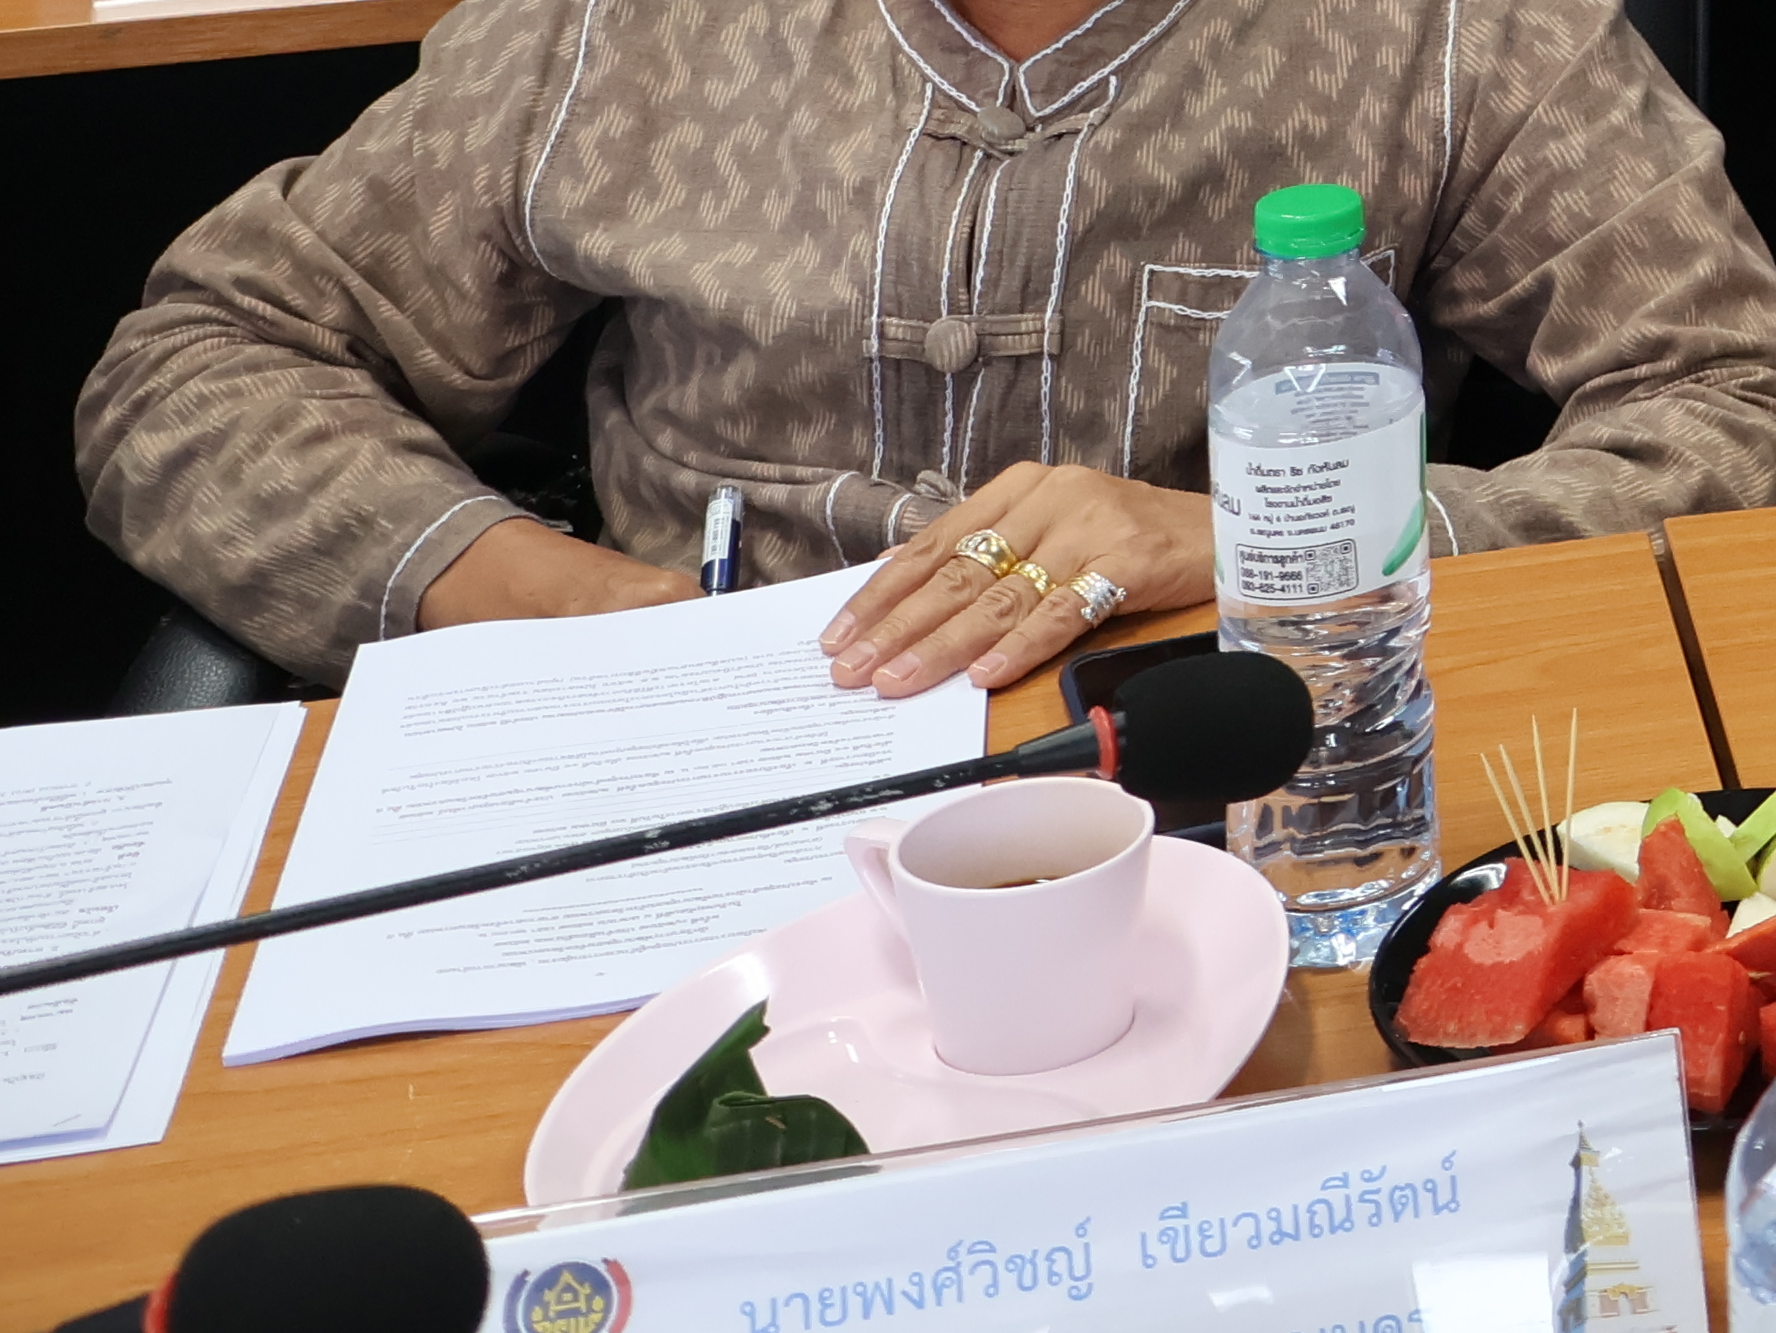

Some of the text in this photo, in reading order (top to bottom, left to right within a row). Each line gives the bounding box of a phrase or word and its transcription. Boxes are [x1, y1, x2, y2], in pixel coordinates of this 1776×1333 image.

[741, 1150, 1463, 1333] นายพงศ์วิชญ์ เขียวมณีรัตน์
